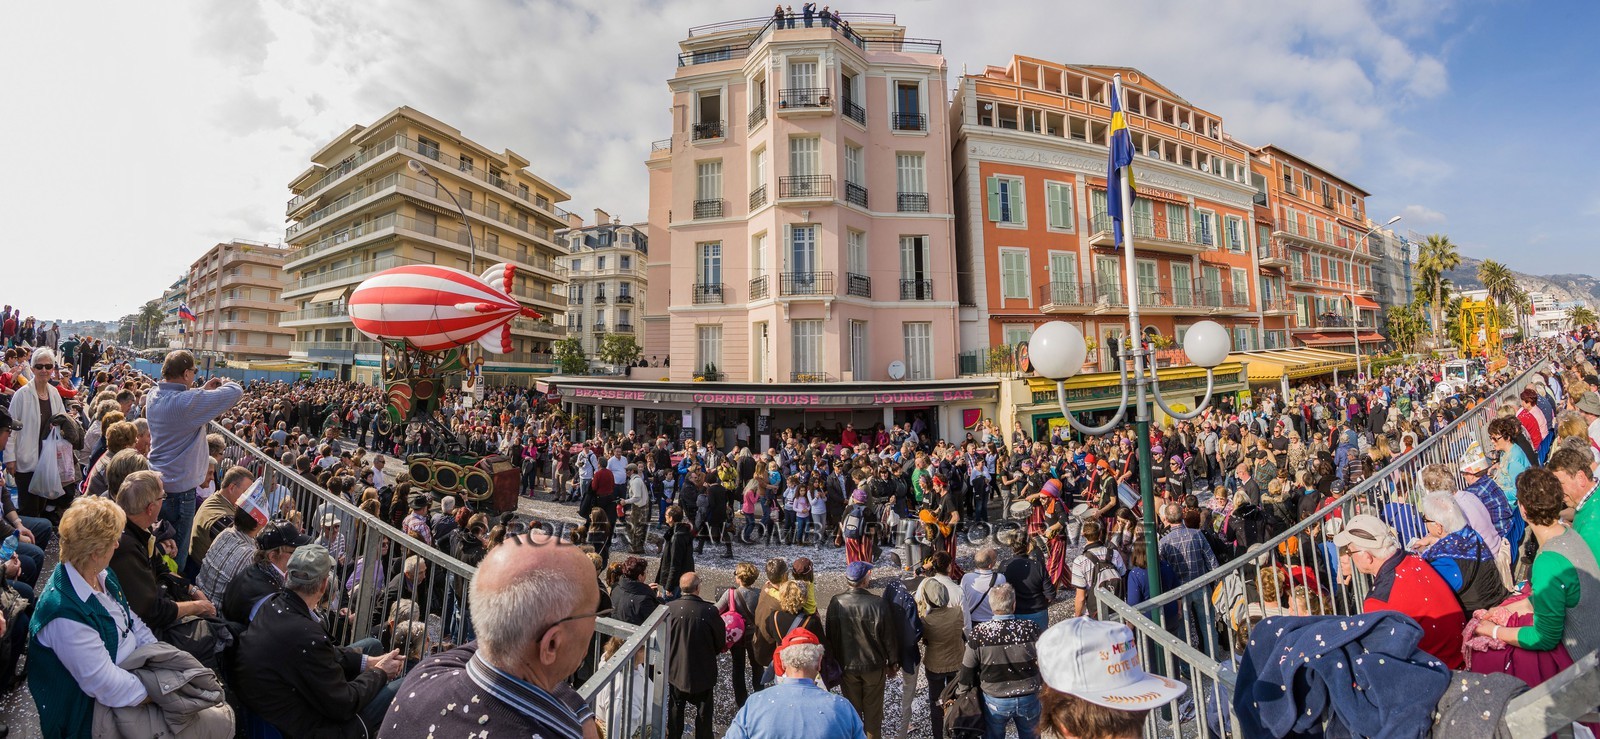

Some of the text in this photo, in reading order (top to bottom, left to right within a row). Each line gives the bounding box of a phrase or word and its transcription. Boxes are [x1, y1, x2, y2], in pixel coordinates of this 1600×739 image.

[1140, 187, 1174, 200] BRISTOL
[575, 387, 646, 400] BRASSERIE
[693, 389, 974, 405] CORNER HOUSE LOUNGE BAR
[1107, 659, 1130, 675] COTE
